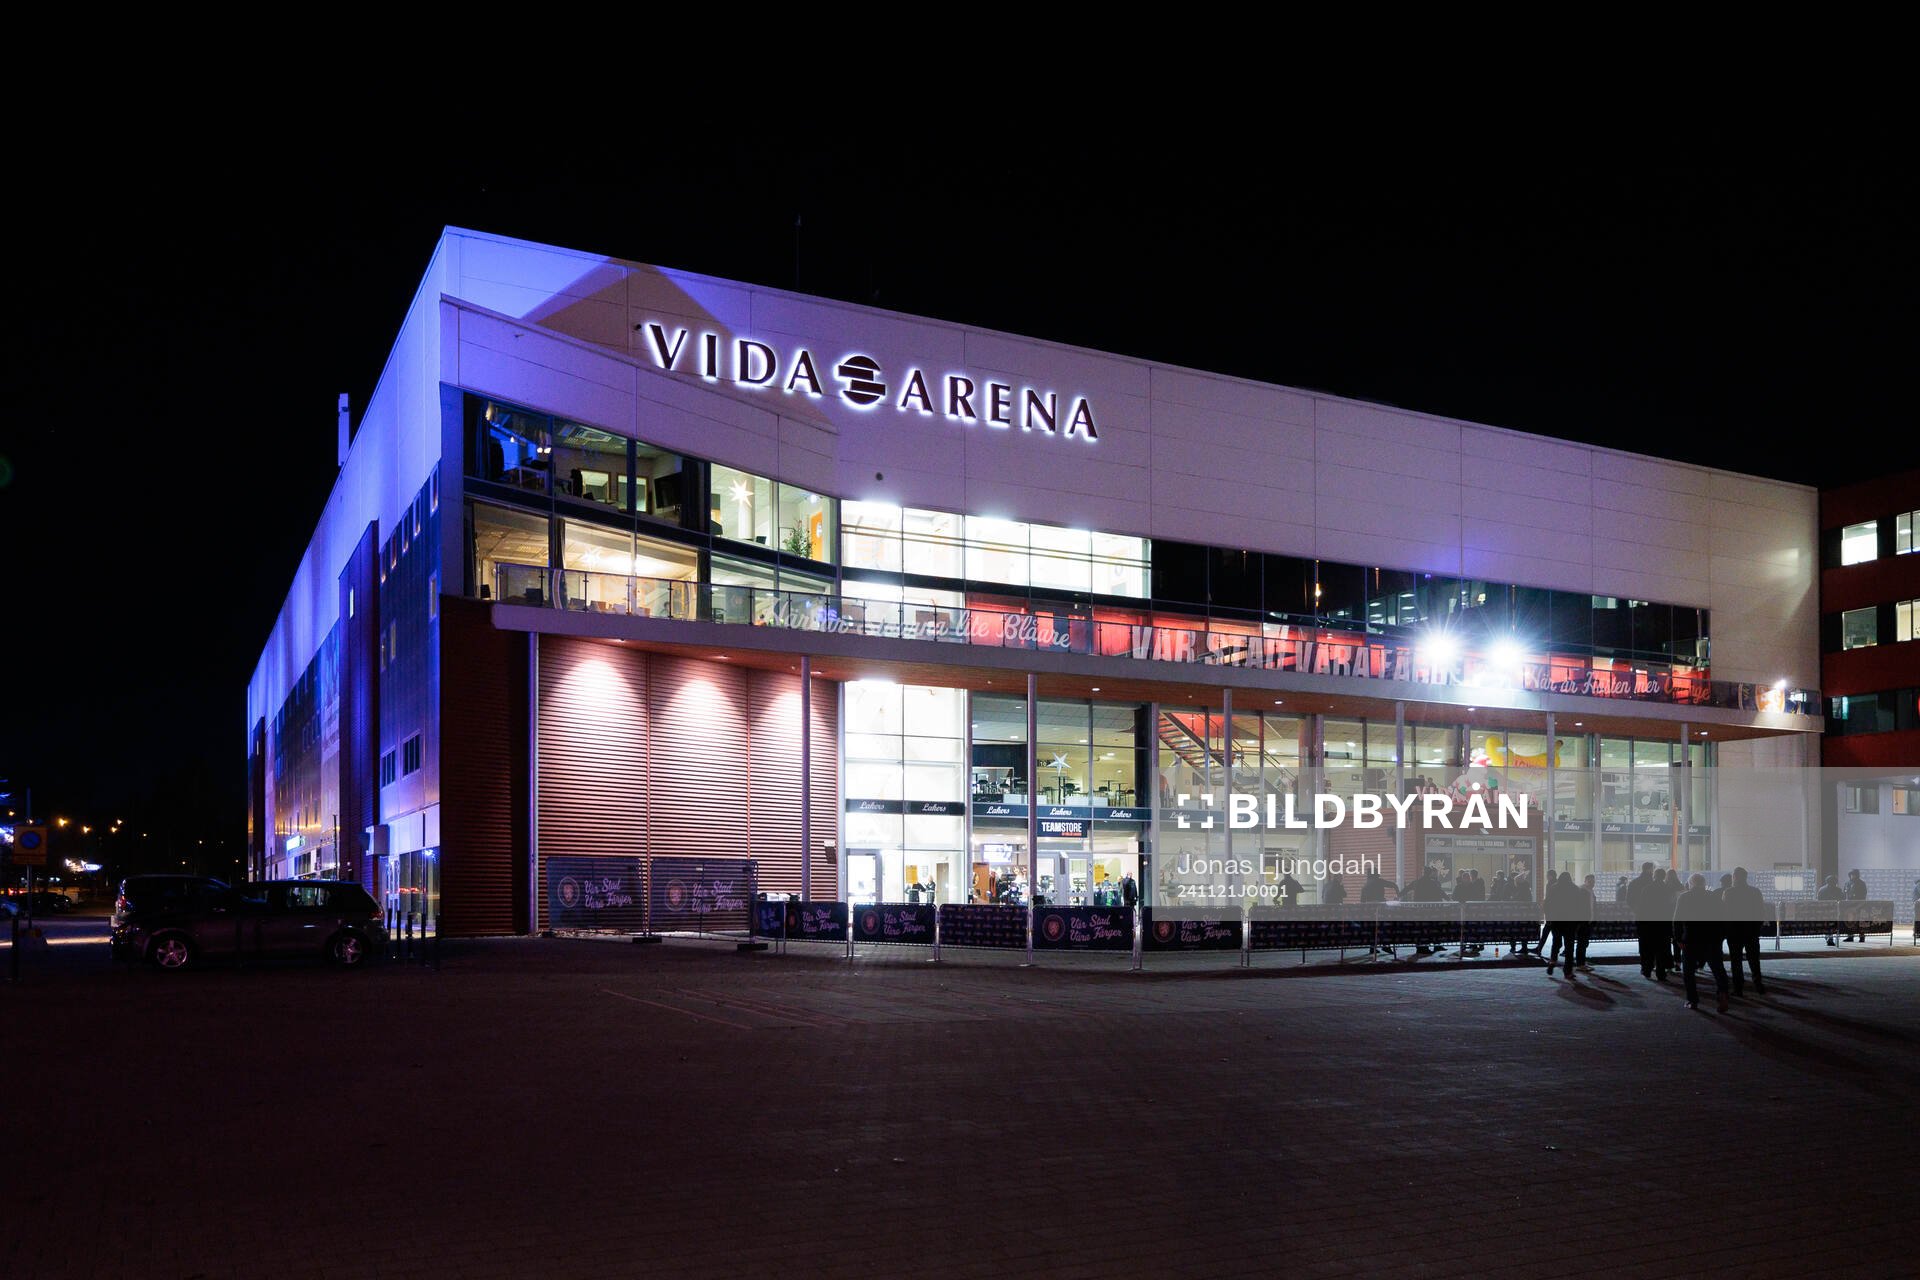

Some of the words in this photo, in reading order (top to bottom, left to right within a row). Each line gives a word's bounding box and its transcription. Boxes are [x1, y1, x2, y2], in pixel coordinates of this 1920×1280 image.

[648, 323, 823, 396] VIDA
[901, 368, 1099, 440] ARENA
[996, 613, 1071, 649] Blåare
[859, 801, 885, 811] Lakers
[921, 803, 947, 812] Lakers
[986, 805, 1010, 815] Lakers
[1049, 807, 1073, 816] Lakers
[1110, 810, 1132, 819] Lakers
[1041, 821, 1083, 833] TEAMSTORE
